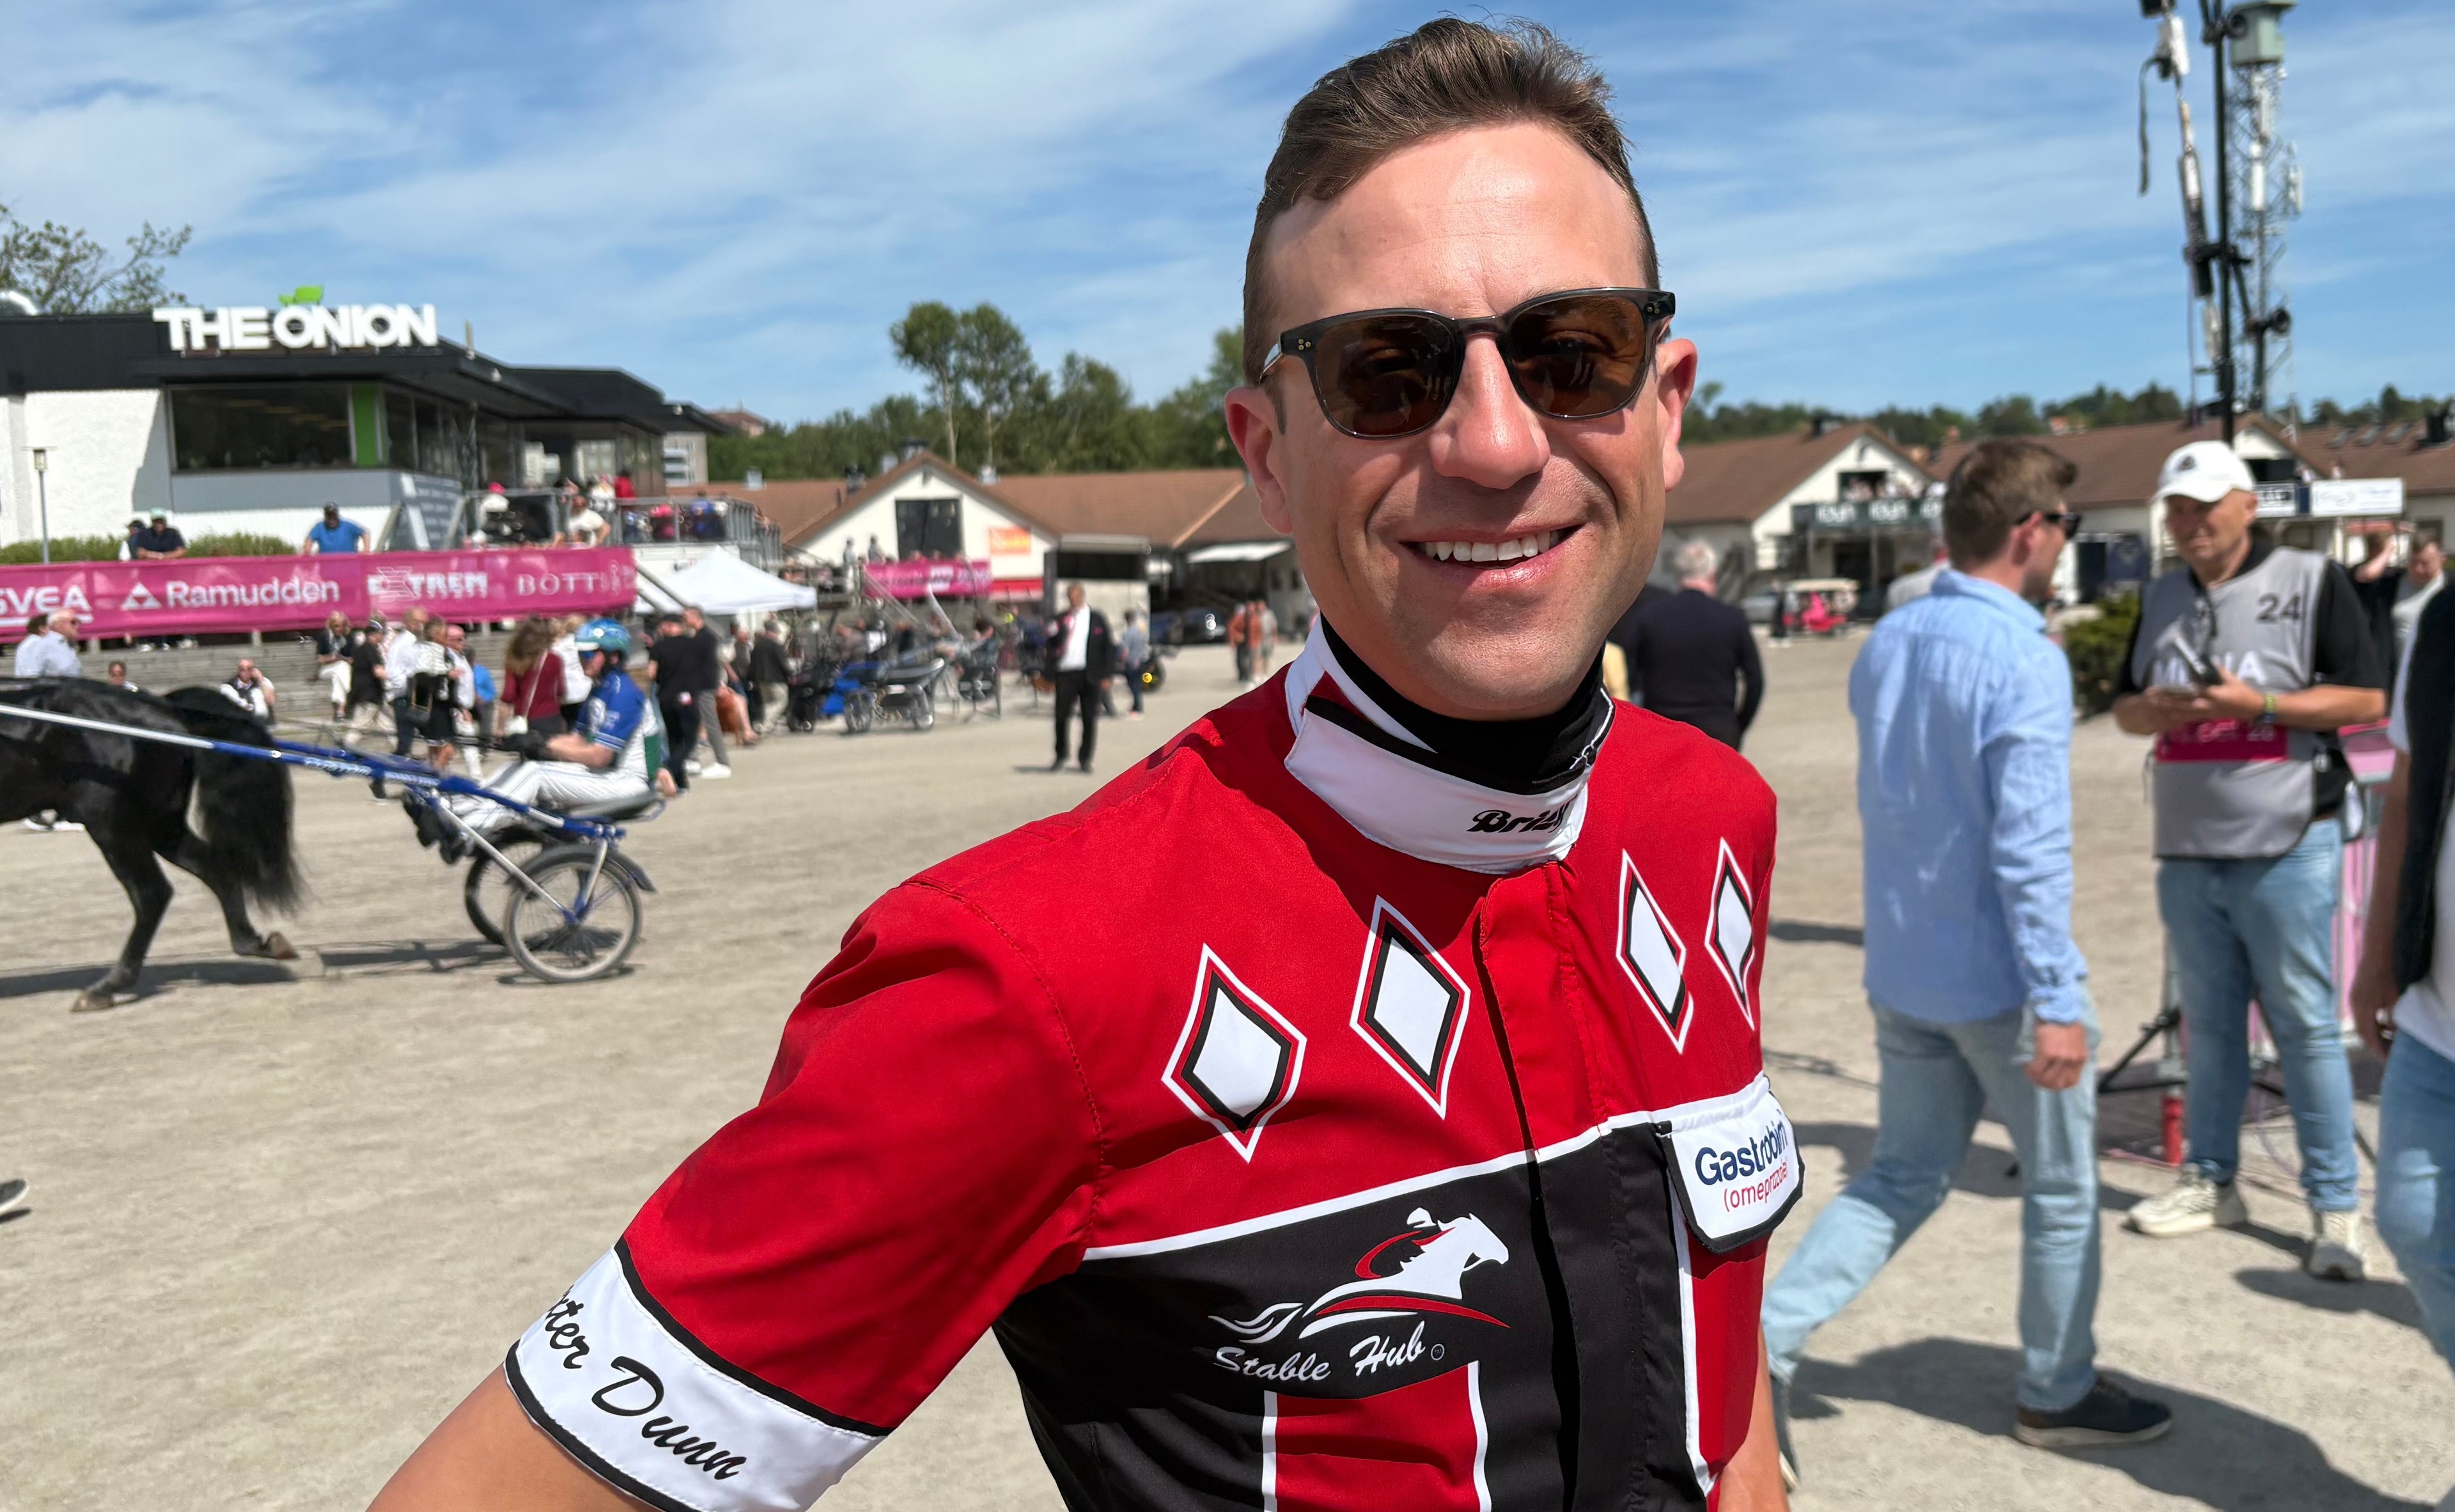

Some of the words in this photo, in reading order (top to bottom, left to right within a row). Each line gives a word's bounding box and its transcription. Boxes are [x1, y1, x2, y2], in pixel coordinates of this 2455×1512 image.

[153, 306, 271, 350] THE
[273, 303, 439, 349] ONION
[166, 575, 339, 607] Ramudden
[2257, 595, 2301, 623] 24
[1214, 1346, 1331, 1381] Stable
[1349, 1321, 1426, 1376] Hub
[591, 1355, 747, 1480] Dunn
